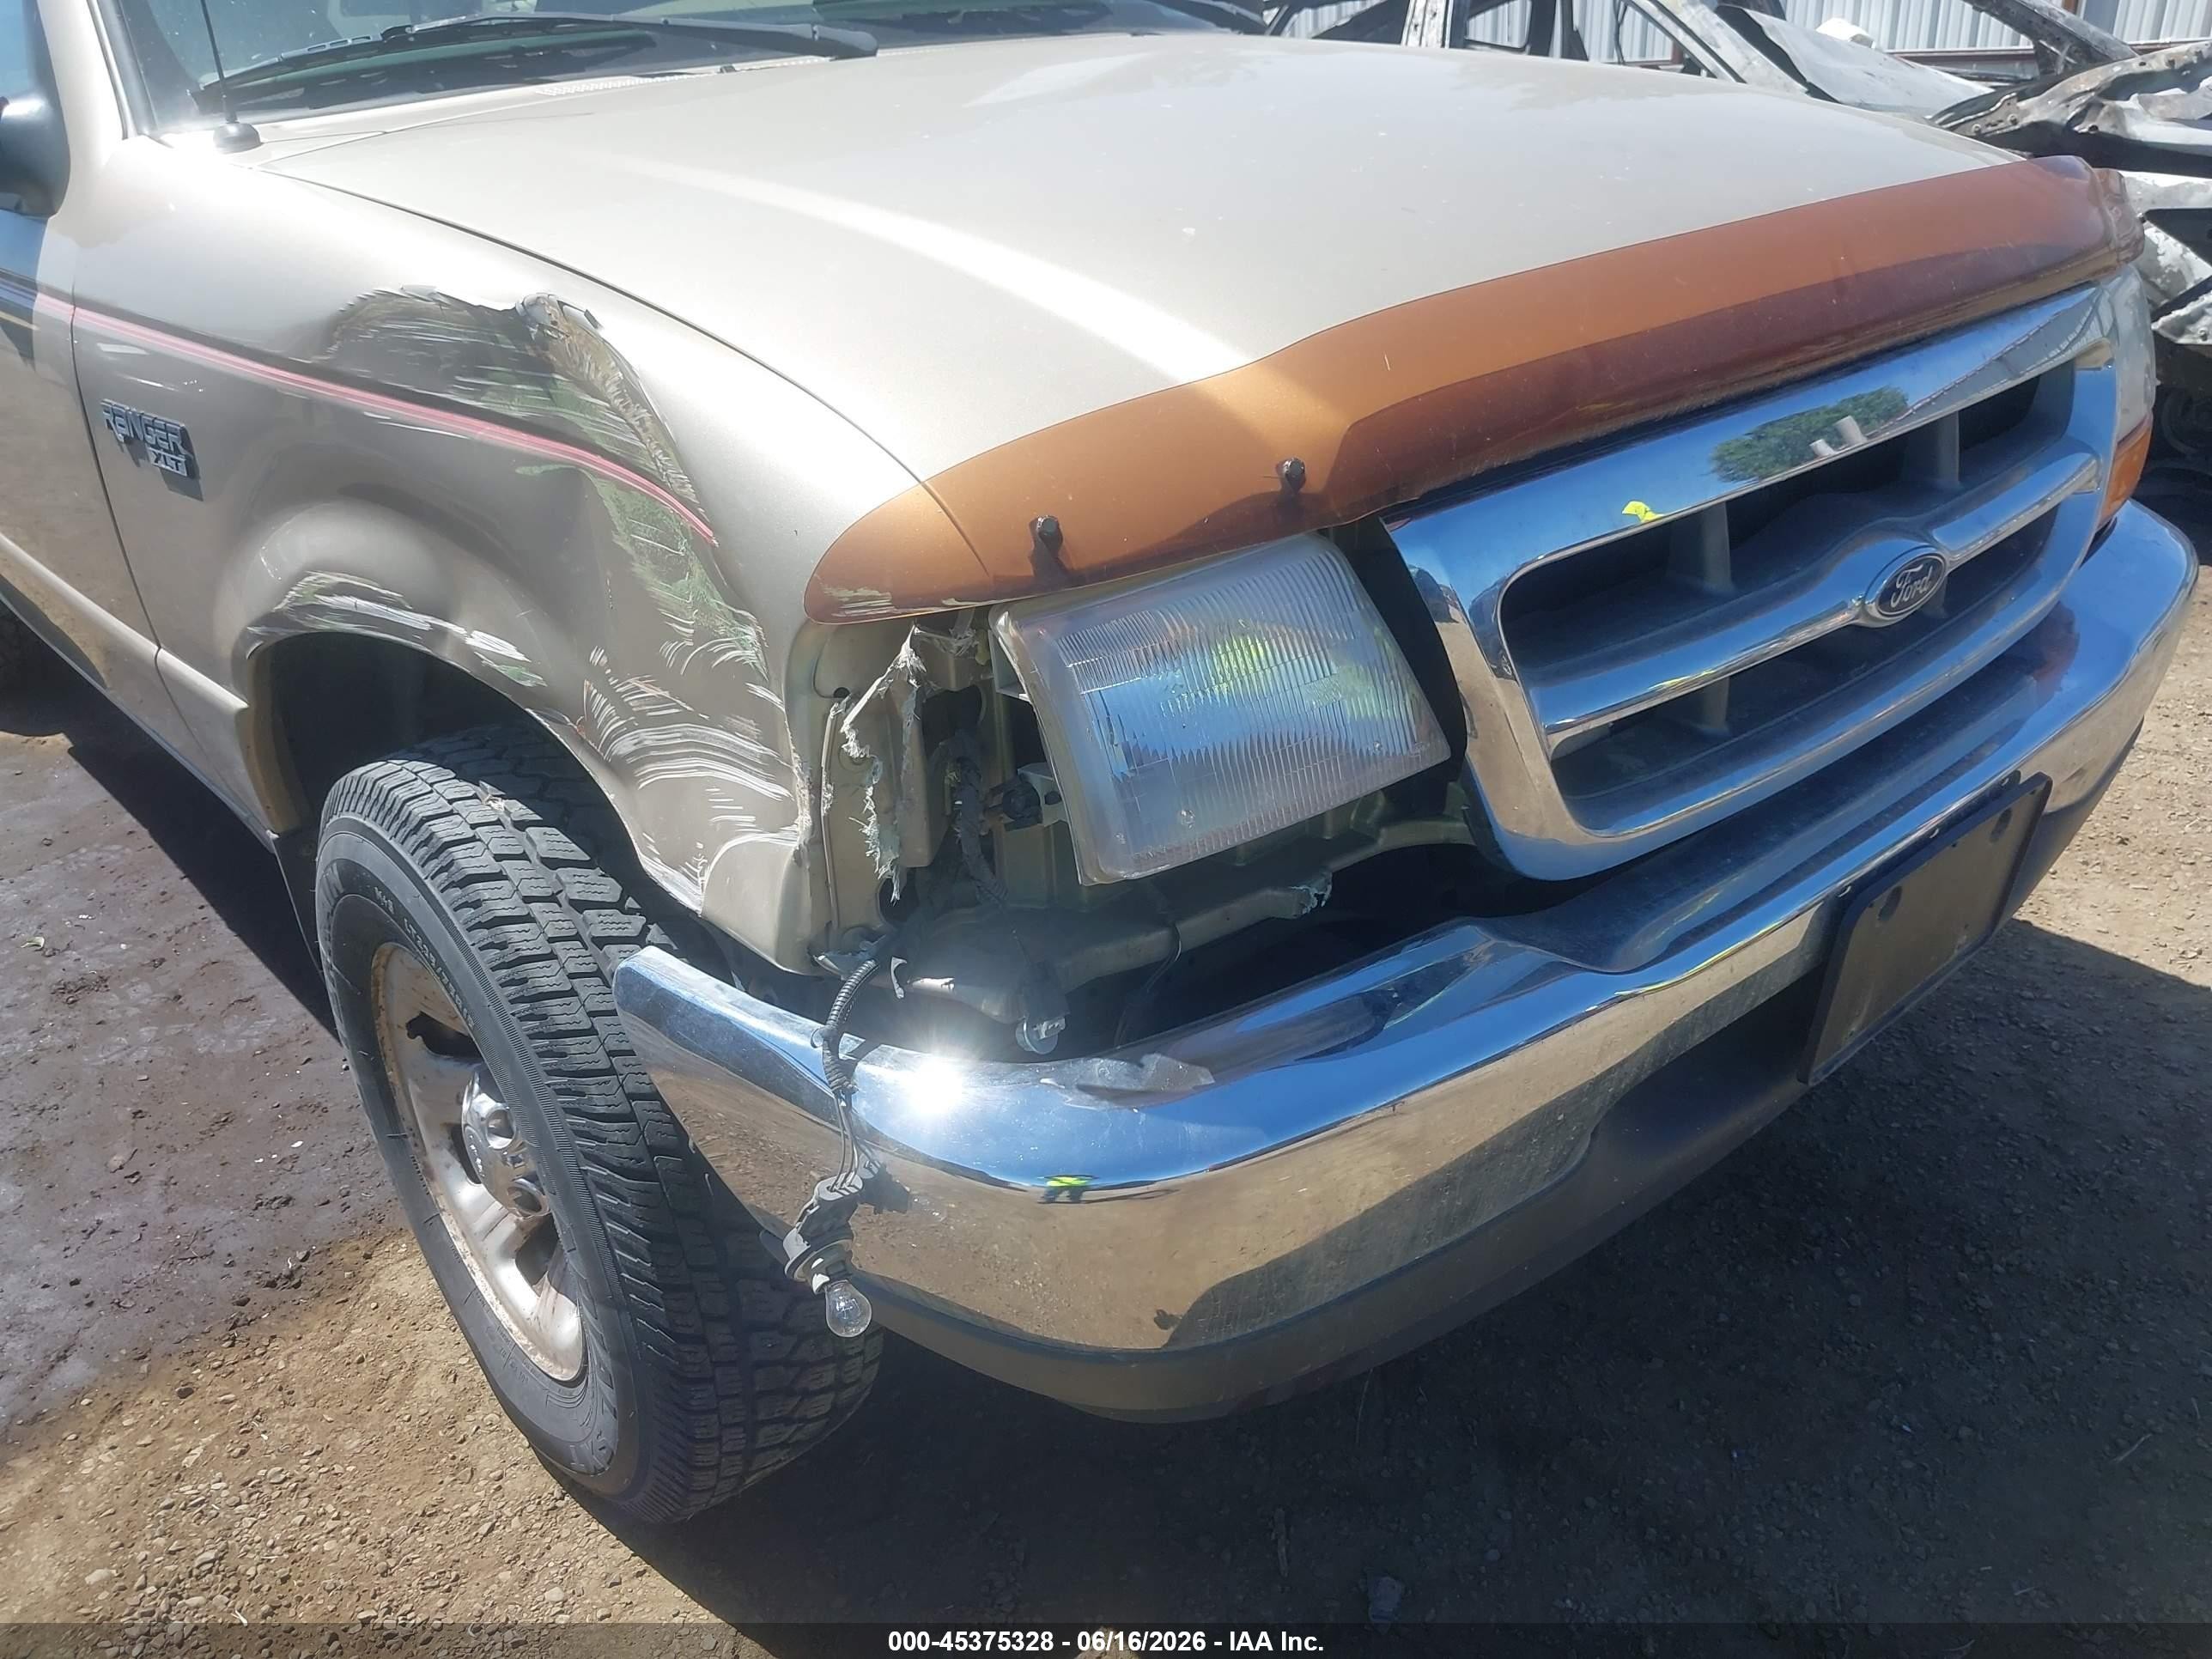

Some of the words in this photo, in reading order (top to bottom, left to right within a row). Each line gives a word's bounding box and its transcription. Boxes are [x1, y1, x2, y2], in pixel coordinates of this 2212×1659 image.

[101, 399, 194, 459] RANGER
[149, 448, 187, 476] XLT
[1890, 563, 1933, 608] Ford
